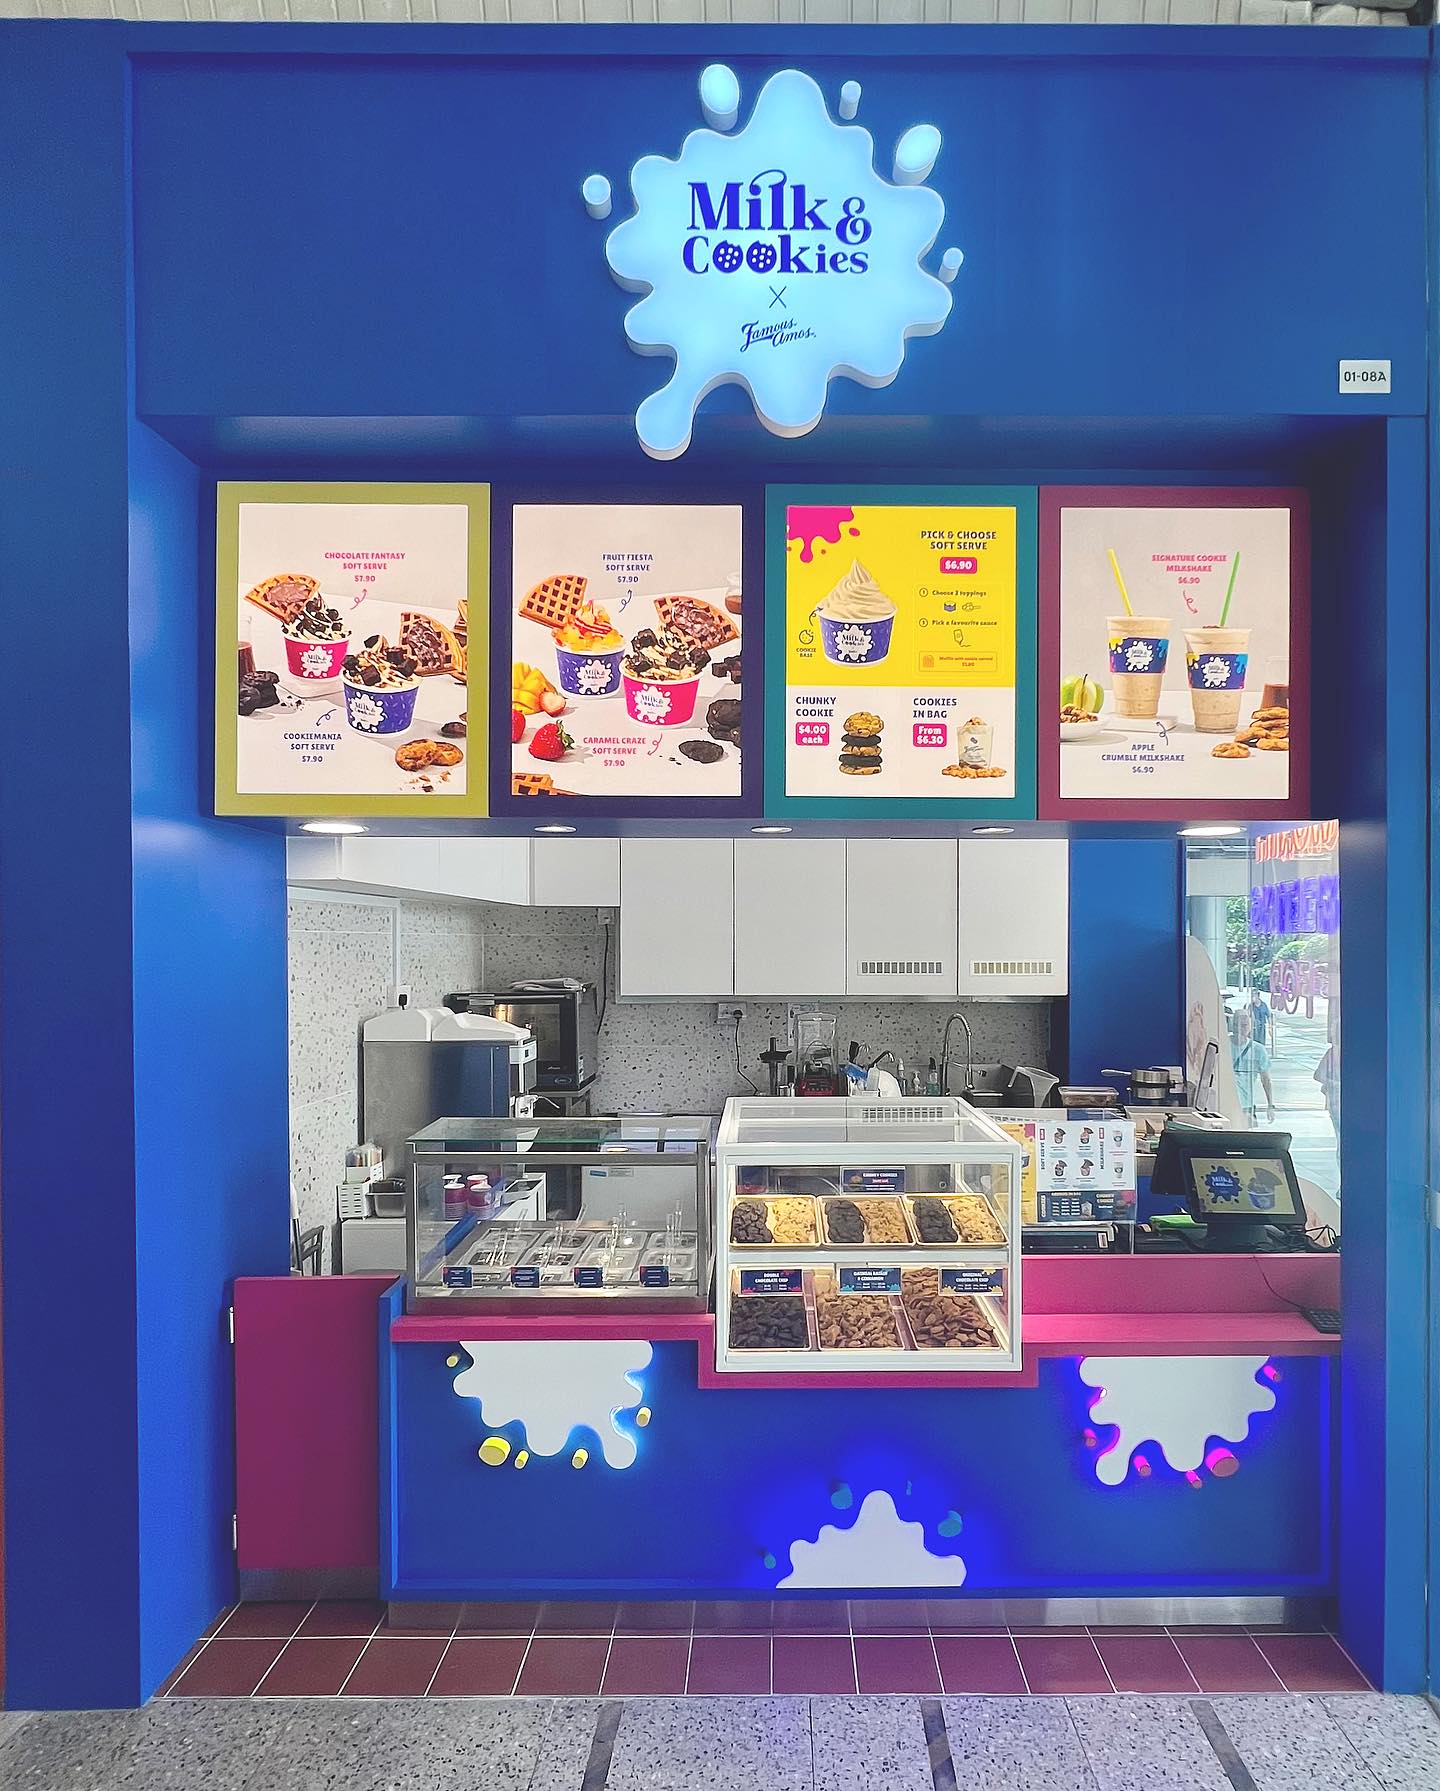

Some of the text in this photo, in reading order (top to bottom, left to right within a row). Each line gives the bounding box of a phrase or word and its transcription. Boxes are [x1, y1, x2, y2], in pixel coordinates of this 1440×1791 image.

[686, 170, 872, 245] Milk &
[682, 234, 869, 274] Cookies
[1344, 371, 1387, 382] 01-08A
[920, 530, 997, 540] PICK & CHOOSE
[930, 541, 988, 550] SOFT SERVE
[324, 552, 406, 560] CHOCOLATE FANTASY
[602, 554, 654, 562] FRUIT FIESTA
[944, 560, 972, 571] $6.90
[1178, 576, 1200, 584] $6.90
[796, 696, 837, 705] CHUNKY
[913, 698, 957, 707] COOKIES
[795, 708, 834, 717] COOKIE
[913, 710, 948, 718] IN BAG
[798, 725, 827, 735] $4.00
[918, 726, 942, 735] From
[802, 735, 823, 744] each
[917, 735, 943, 745] $6.30
[290, 743, 335, 751] SOFT SERVE
